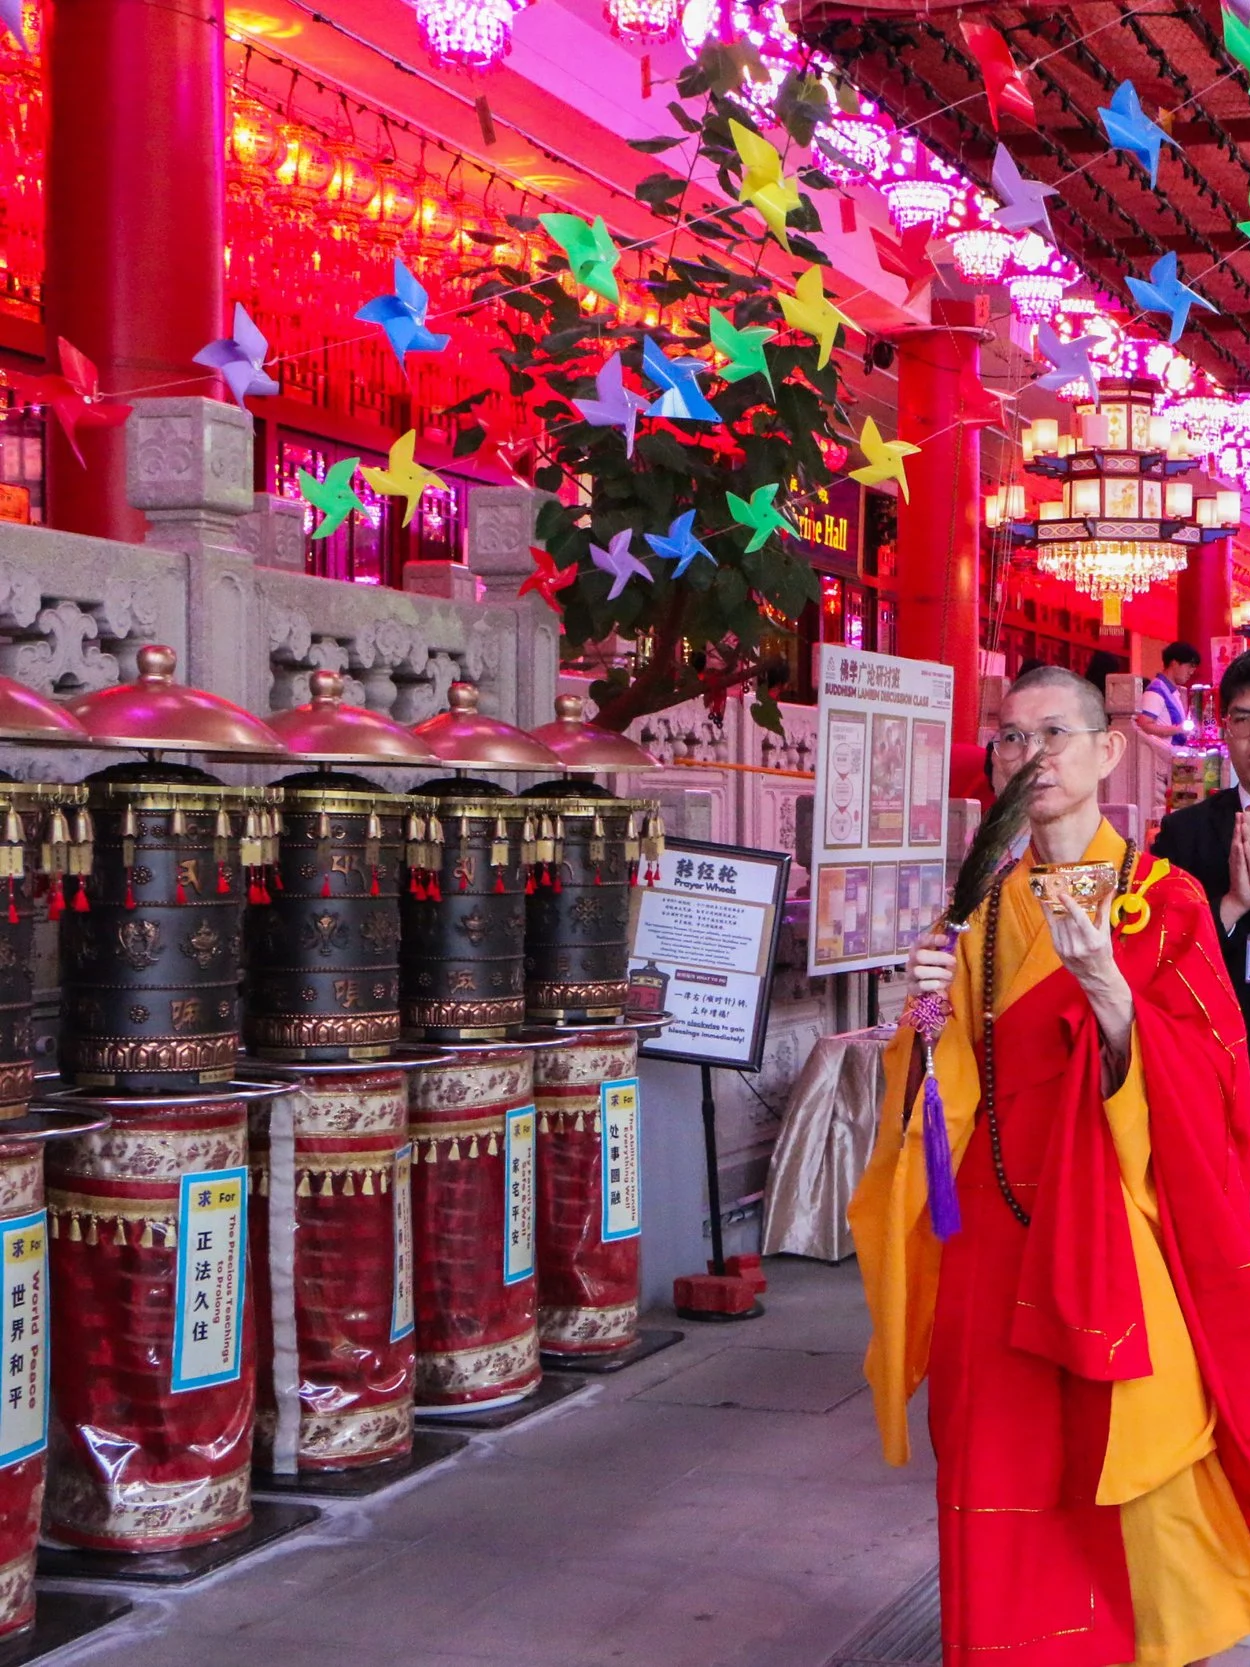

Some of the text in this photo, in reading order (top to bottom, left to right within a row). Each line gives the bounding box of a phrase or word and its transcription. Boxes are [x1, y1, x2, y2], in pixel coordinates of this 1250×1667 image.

[824, 514, 847, 551] Hall
[825, 682, 857, 698] BUDDHISM
[857, 687, 880, 701] LAMRIM
[881, 690, 913, 705] DISCUSSION
[913, 695, 929, 707] CLASS
[675, 858, 738, 884] 转经轮
[674, 878, 737, 895] Prayer Wheels
[668, 1027, 745, 1043] blessings immediately!
[687, 1019, 720, 1031] clockwise
[730, 1026, 745, 1034] gain
[611, 1094, 619, 1106] 求
[623, 1095, 633, 1103] For
[197, 1190, 212, 1207] 求
[219, 1192, 236, 1203] For
[511, 1157, 520, 1247] 家宅平安
[12, 1238, 25, 1259] 求
[30, 1240, 41, 1251] For
[192, 1231, 213, 1342] 正法久住
[212, 1260, 224, 1324] to Prolong
[221, 1215, 236, 1364] The Precious Teachings
[8, 1283, 26, 1409] 世界和平
[28, 1270, 40, 1409] World Peace
